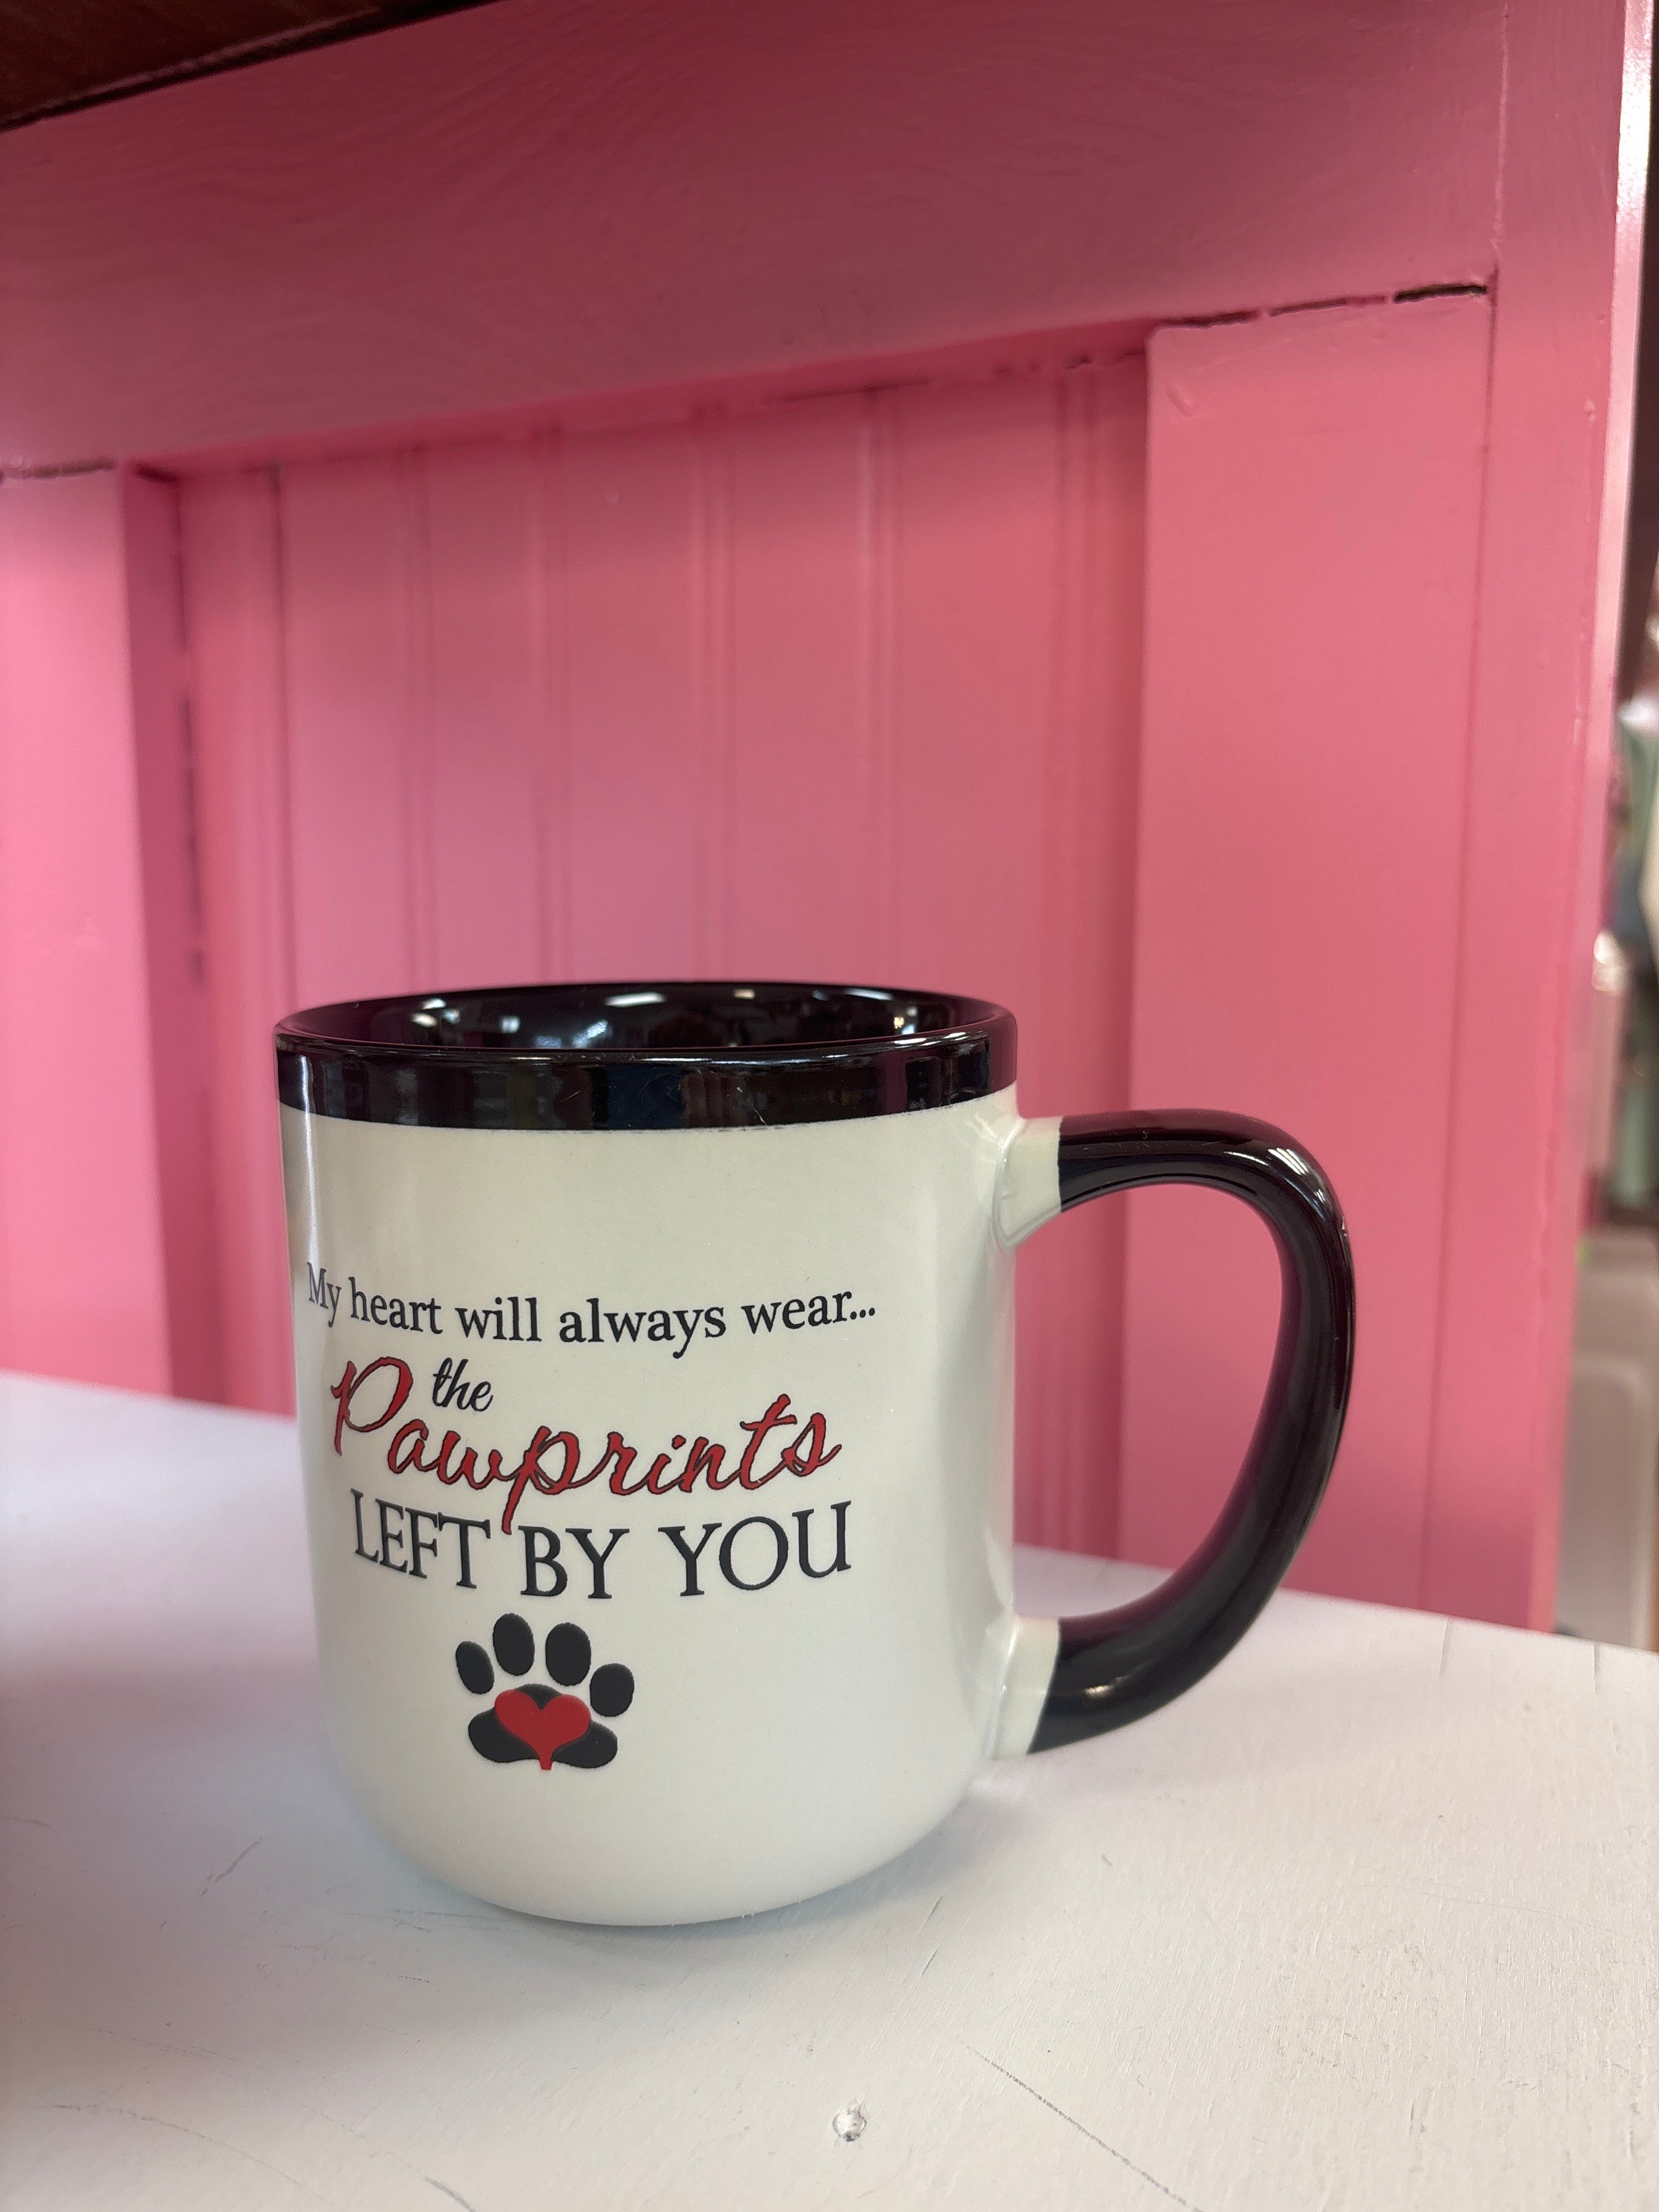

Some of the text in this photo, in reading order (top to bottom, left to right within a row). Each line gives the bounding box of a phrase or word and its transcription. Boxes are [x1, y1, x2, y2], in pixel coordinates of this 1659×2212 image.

[307, 1262, 876, 1358] My heart will always wear...
[432, 1357, 494, 1412] the
[330, 1356, 842, 1534] Pawprints
[350, 1488, 851, 1599] LEFT BY YOU
